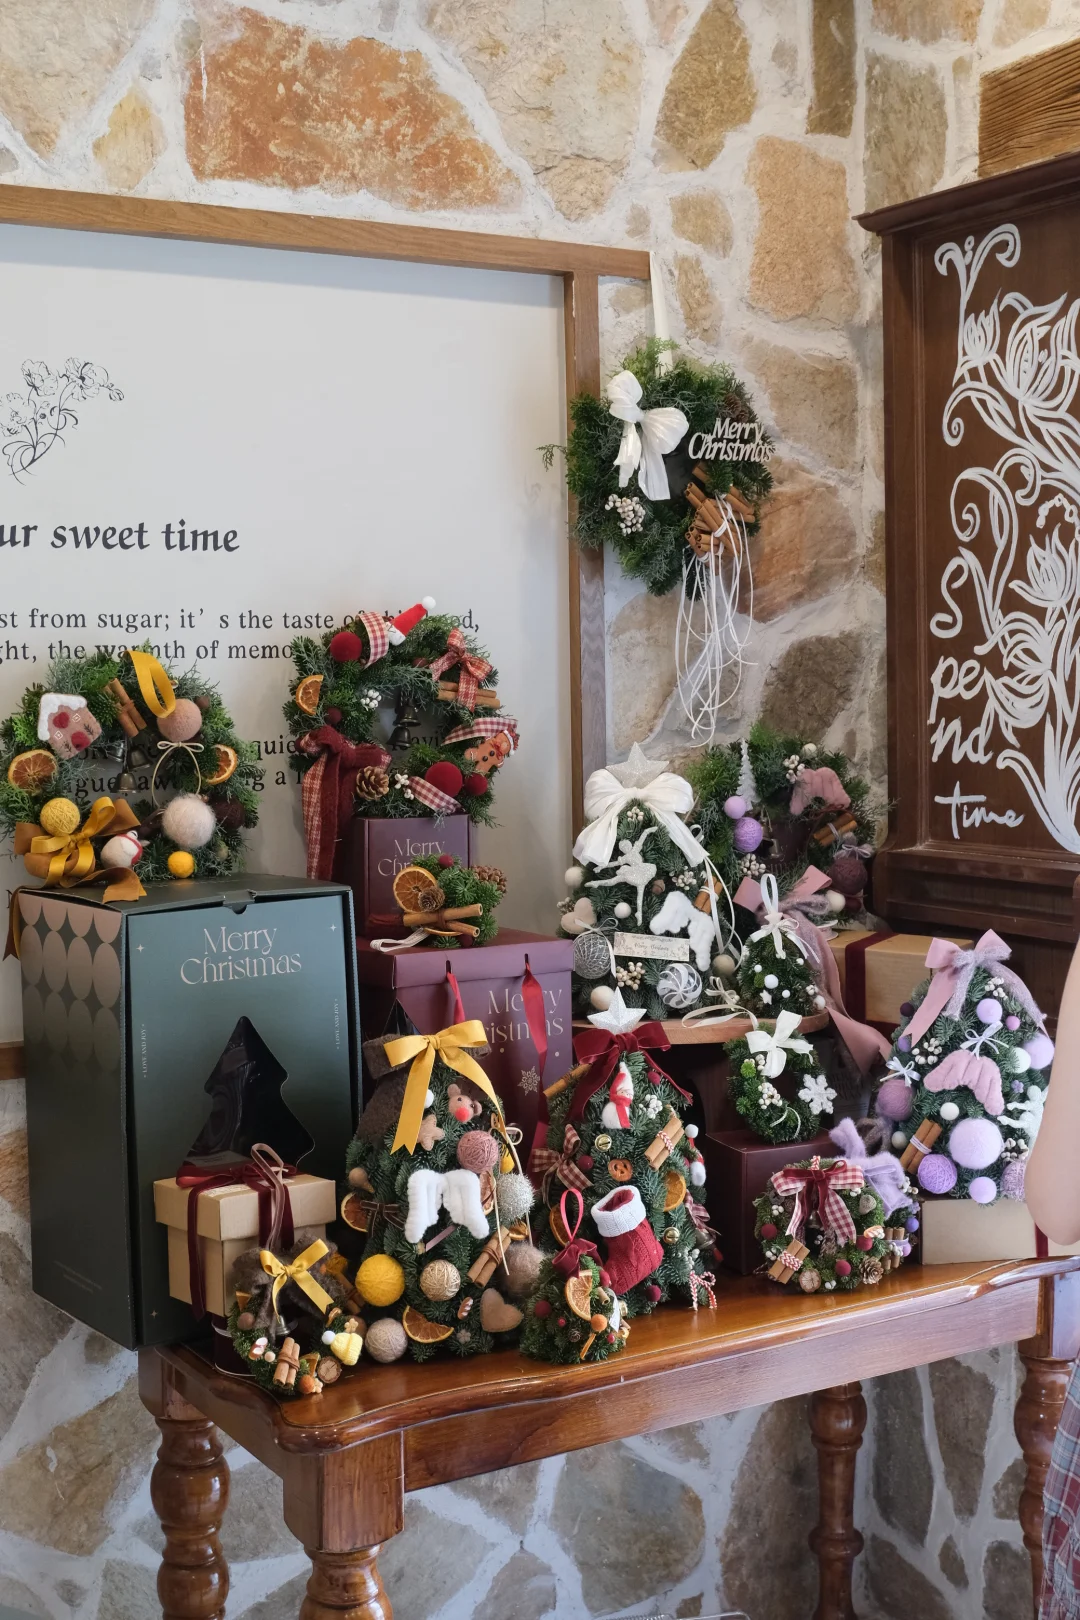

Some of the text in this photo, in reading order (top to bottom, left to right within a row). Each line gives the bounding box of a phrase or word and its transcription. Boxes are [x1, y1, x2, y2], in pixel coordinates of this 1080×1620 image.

[713, 417, 763, 443] Merry
[688, 432, 773, 462] Christmas
[51, 522, 150, 550] sweet
[161, 518, 240, 552] time
[29, 608, 87, 629] from
[97, 612, 170, 634] sugar;
[239, 610, 273, 629] the
[283, 611, 334, 629] taste
[0, 640, 37, 665] ht,
[48, 640, 86, 660] the
[196, 640, 219, 660] of
[275, 770, 287, 786] a
[203, 926, 278, 955] Merry
[180, 953, 302, 985] Christmas
